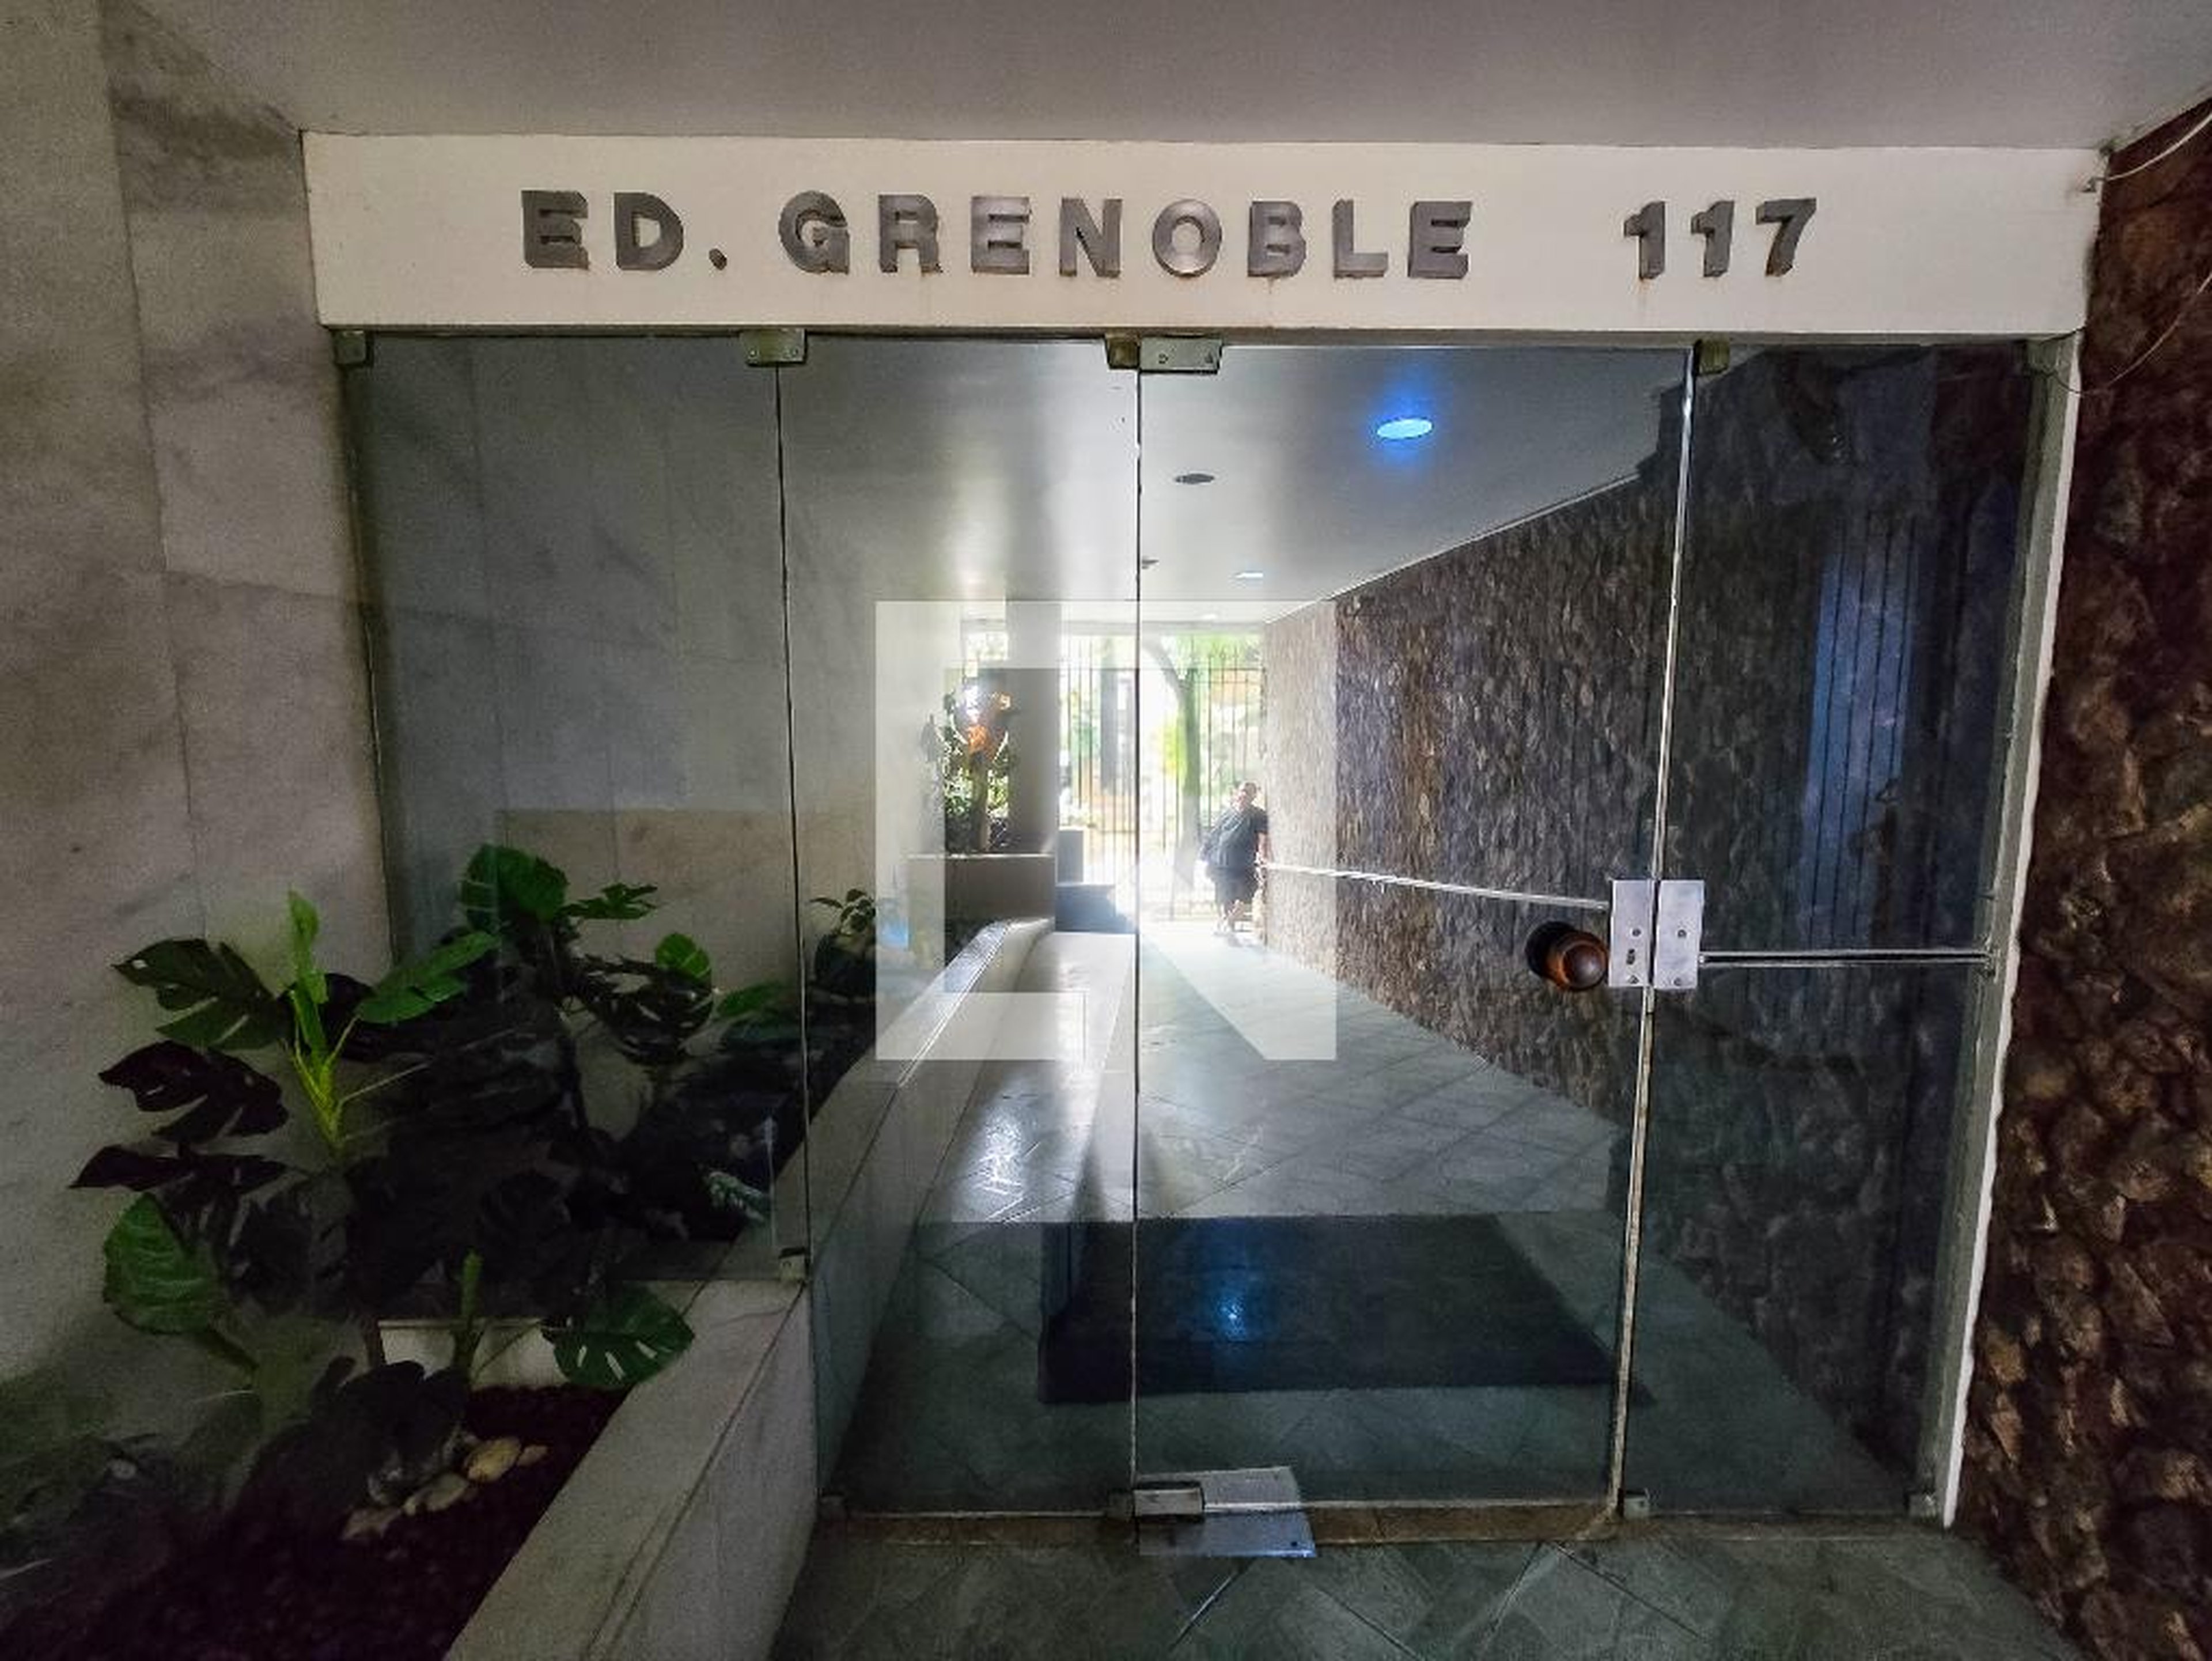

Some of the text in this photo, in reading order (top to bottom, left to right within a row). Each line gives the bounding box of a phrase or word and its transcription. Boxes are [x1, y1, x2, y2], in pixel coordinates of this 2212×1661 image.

[522, 190, 1817, 280] ED. GRENOBLE 117
